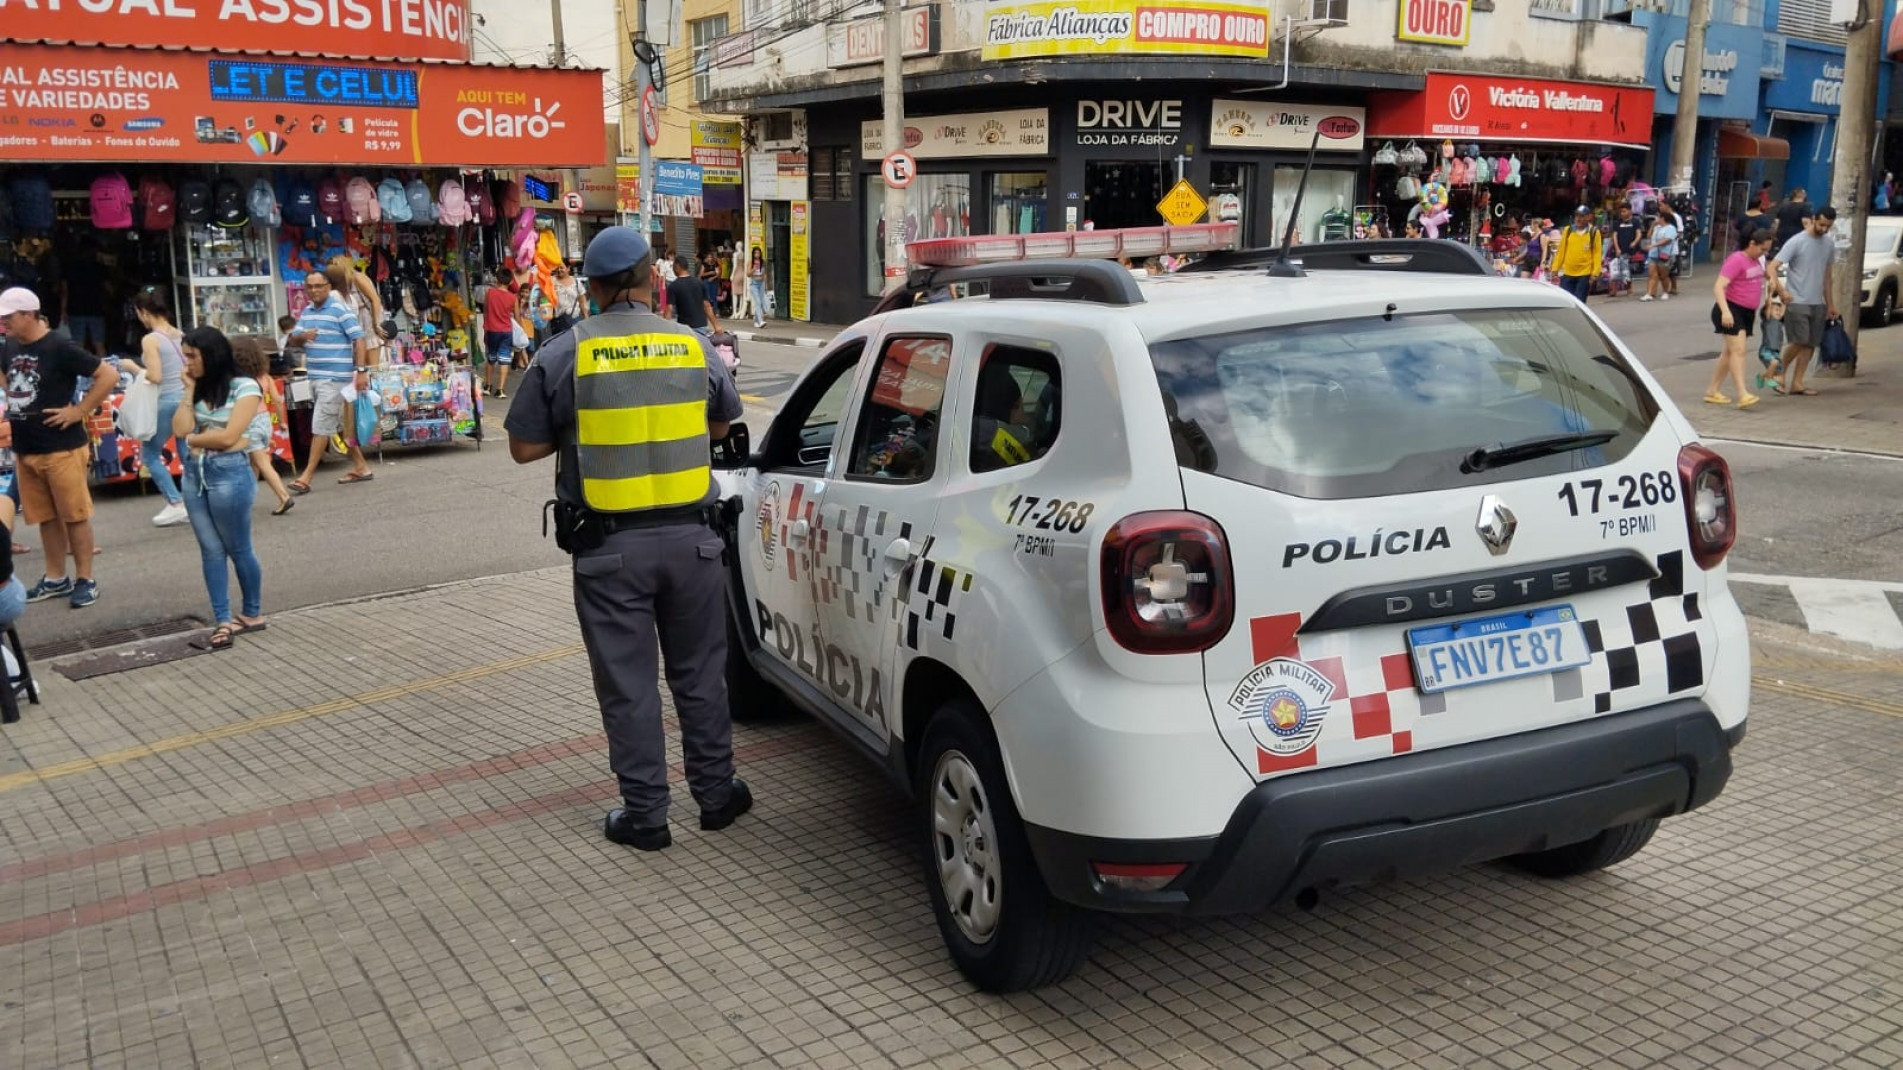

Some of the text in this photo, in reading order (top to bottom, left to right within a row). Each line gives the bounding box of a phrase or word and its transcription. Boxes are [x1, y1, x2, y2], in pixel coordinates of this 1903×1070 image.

[988, 11, 1265, 44] Fábrica Alianças COMPRO OURO
[1408, 0, 1462, 37] OURO
[0, 66, 179, 89] AL ASSISTÊNCIA
[284, 69, 306, 96] E
[12, 89, 150, 110] VARIEDADES
[457, 90, 526, 104] AQUI TEM
[28, 118, 77, 128] NOKIA
[457, 107, 550, 138] Claro
[1077, 99, 1182, 127] DRIVE
[51, 135, 92, 147] Baterias
[105, 136, 133, 147] Fones
[149, 137, 180, 148] Ouvido
[366, 128, 399, 138] de vidro
[381, 140, 401, 152] 9,99
[1077, 132, 1178, 146] LOJA DA FÁBRICA
[1558, 470, 1677, 517] 17-268
[1005, 494, 1095, 534] 17-268
[1282, 526, 1452, 569] POLÍCIA
[1386, 565, 1608, 617] DUSTER
[1480, 622, 1508, 634] BRASIL
[755, 597, 888, 734] POLÍCIA
[1428, 627, 1564, 684] FNV7E87
[1279, 663, 1327, 696] MILITAR
